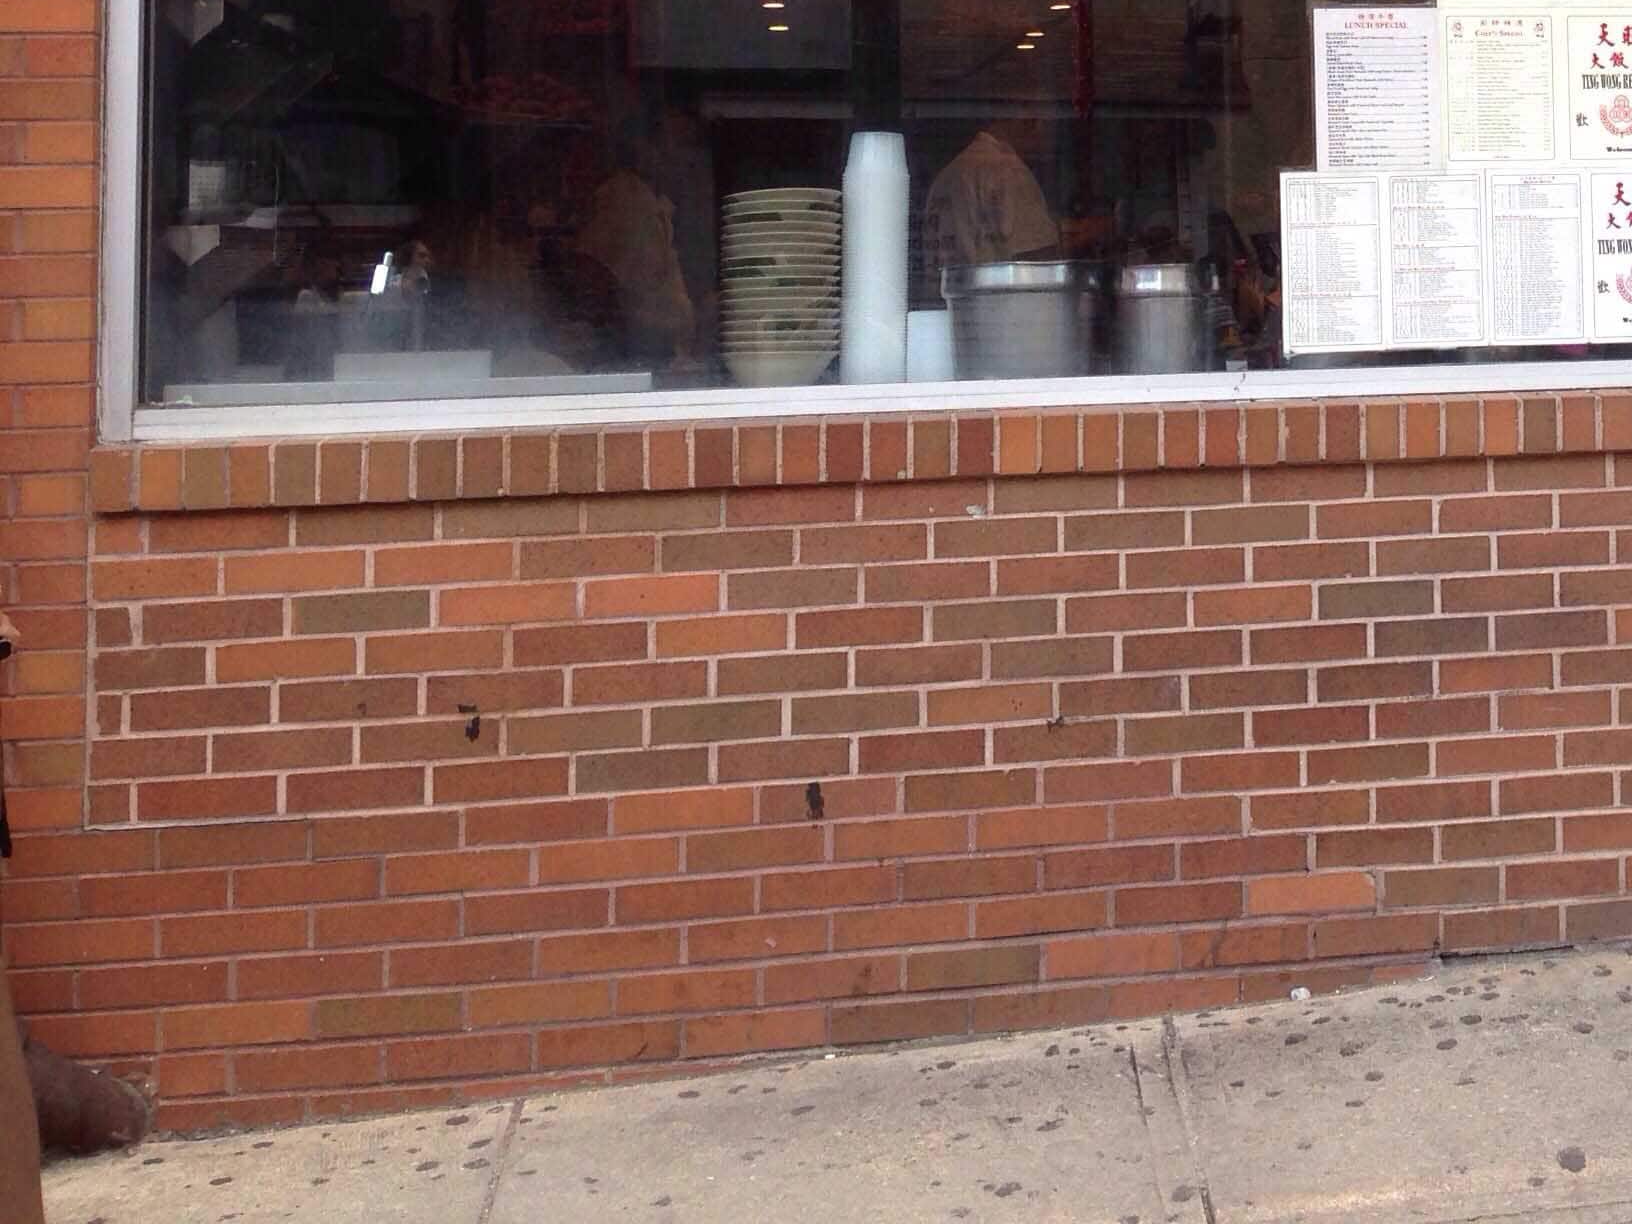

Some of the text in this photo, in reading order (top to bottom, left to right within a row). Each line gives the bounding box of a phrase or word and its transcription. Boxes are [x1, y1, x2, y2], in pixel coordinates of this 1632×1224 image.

[1582, 74, 1599, 89] TING
[1600, 74, 1622, 89] WONG
[1597, 239, 1615, 255] TING
